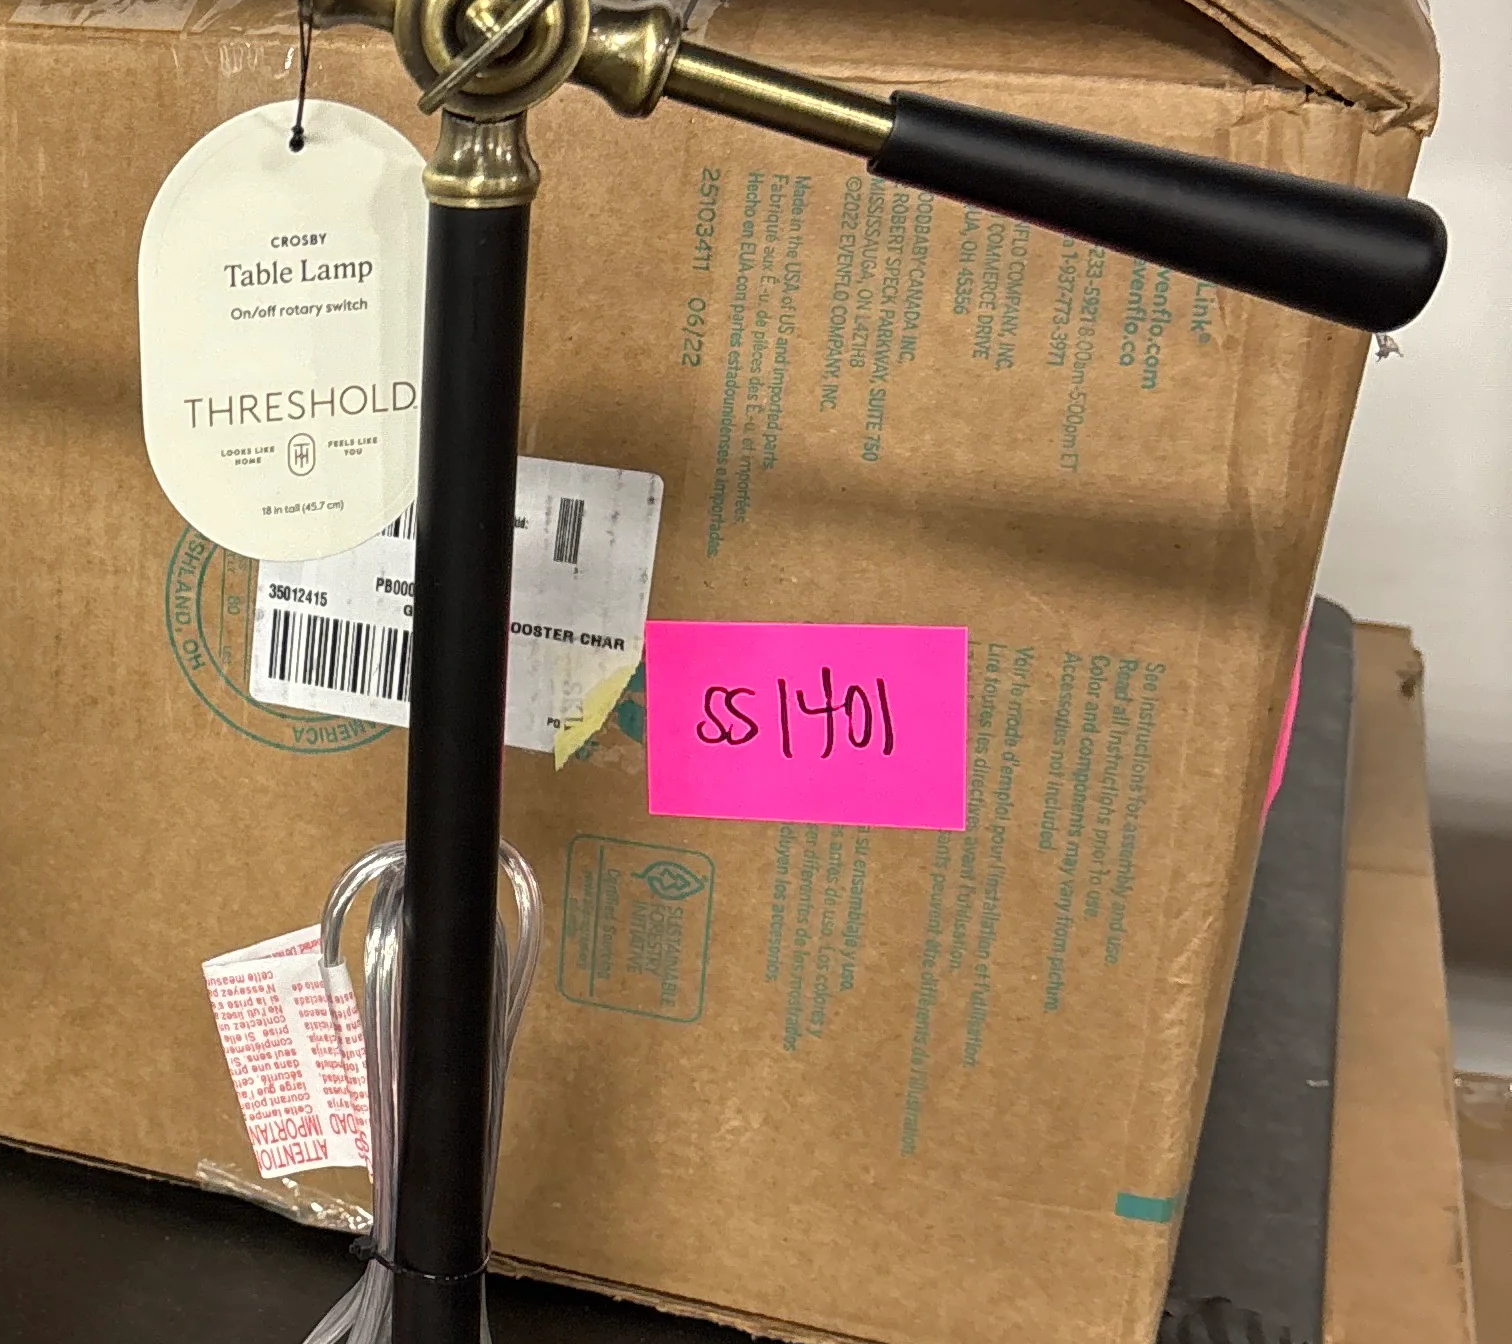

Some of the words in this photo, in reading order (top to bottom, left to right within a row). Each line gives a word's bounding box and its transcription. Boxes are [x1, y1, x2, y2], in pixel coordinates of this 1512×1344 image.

[743, 171, 764, 218] Hecho
[790, 175, 812, 216] Made
[691, 165, 721, 272] 25103411
[741, 220, 755, 238] en
[885, 192, 909, 254] ROBERT
[909, 192, 934, 265] OODBABY
[271, 233, 327, 248] CROSBY
[736, 241, 756, 273] EUA
[785, 235, 804, 259] the
[958, 239, 977, 263] OH
[224, 261, 293, 287] Table
[301, 259, 373, 283] Lamp
[781, 261, 802, 294] USA
[832, 234, 856, 302] EVENFLO
[879, 256, 902, 306] SPECK
[978, 222, 1005, 310] COMMERCE
[734, 275, 749, 301] con
[780, 295, 797, 311] of
[855, 288, 873, 312] ON
[900, 267, 925, 332] CANADA
[952, 266, 974, 316] 45356
[997, 260, 1025, 338] COMPANY,
[231, 305, 276, 320] On/off
[280, 304, 323, 317] rotary
[326, 298, 367, 313] switch
[755, 309, 771, 328] de
[777, 313, 795, 335] US
[1140, 266, 1176, 391] venflo.com
[678, 296, 707, 367] 06/22
[773, 336, 793, 365] and
[867, 308, 895, 385] PARKWAY,
[970, 314, 992, 361] DRIVE
[764, 367, 786, 430] imported
[864, 387, 886, 431] SUITE
[860, 433, 881, 463] 750
[269, 583, 328, 607] 35012415
[376, 577, 415, 597] PB000
[510, 621, 574, 644] OOSTER
[580, 633, 625, 651] CHAR
[1087, 654, 1111, 699] Color
[1114, 658, 1138, 702] Read
[1141, 662, 1166, 693] See
[1052, 651, 1083, 747] Accessories
[1081, 701, 1103, 734] and
[1111, 705, 1132, 726] all
[1048, 749, 1067, 778] not
[1128, 696, 1159, 793] instructions
[1065, 736, 1094, 838] components
[1124, 796, 1146, 820] for
[1057, 839, 1079, 876] may
[1109, 820, 1140, 898] assembly
[1052, 915, 1073, 953] from
[1108, 900, 1130, 934] and
[645, 904, 665, 975] FORESTRY
[662, 906, 683, 1007] SUSTAINABLE
